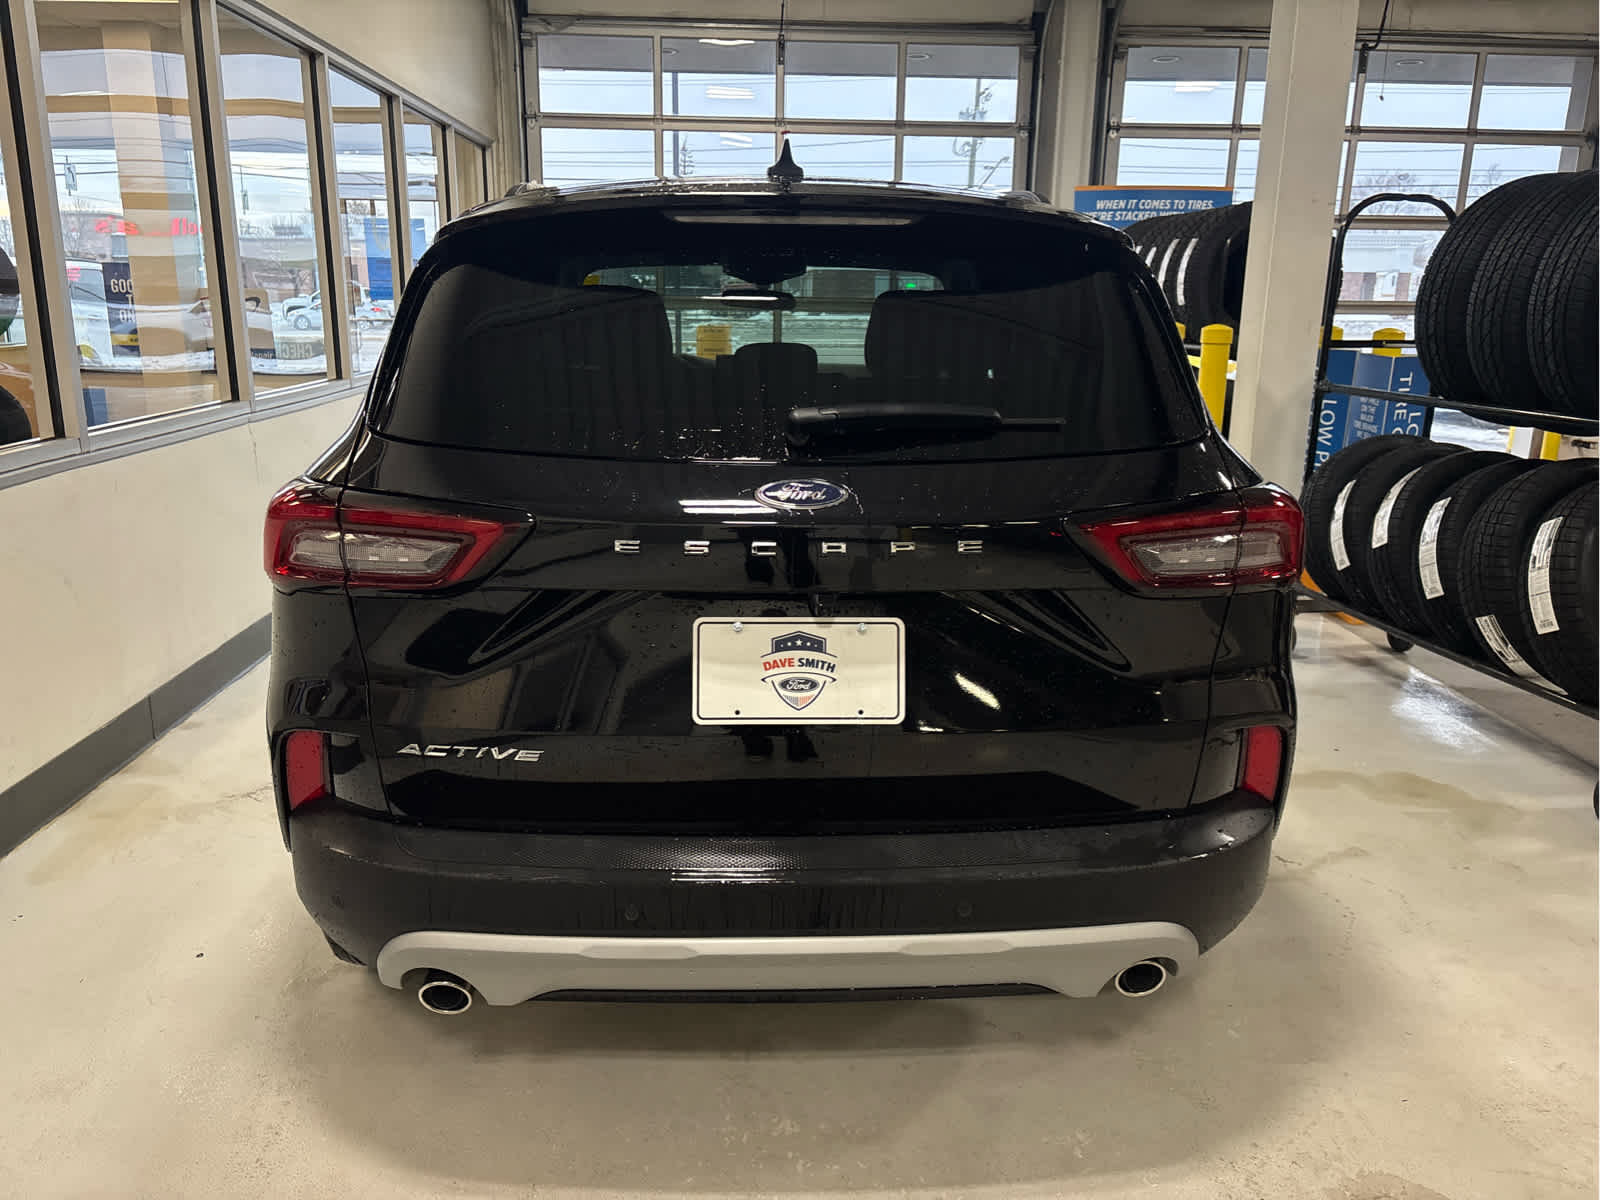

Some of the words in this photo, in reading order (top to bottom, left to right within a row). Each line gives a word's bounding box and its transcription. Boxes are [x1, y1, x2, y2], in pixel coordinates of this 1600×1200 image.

[1095, 199, 1126, 210] WHEN
[1127, 199, 1137, 210] IT
[1138, 199, 1171, 210] COMES
[1173, 199, 1186, 210] TO
[1317, 399, 1337, 446] LOW
[614, 539, 984, 555] ESCAPE
[763, 657, 795, 672] DAVE
[797, 657, 836, 673] SMITH
[785, 679, 811, 690] Ford
[396, 743, 545, 762] ACTIVE
